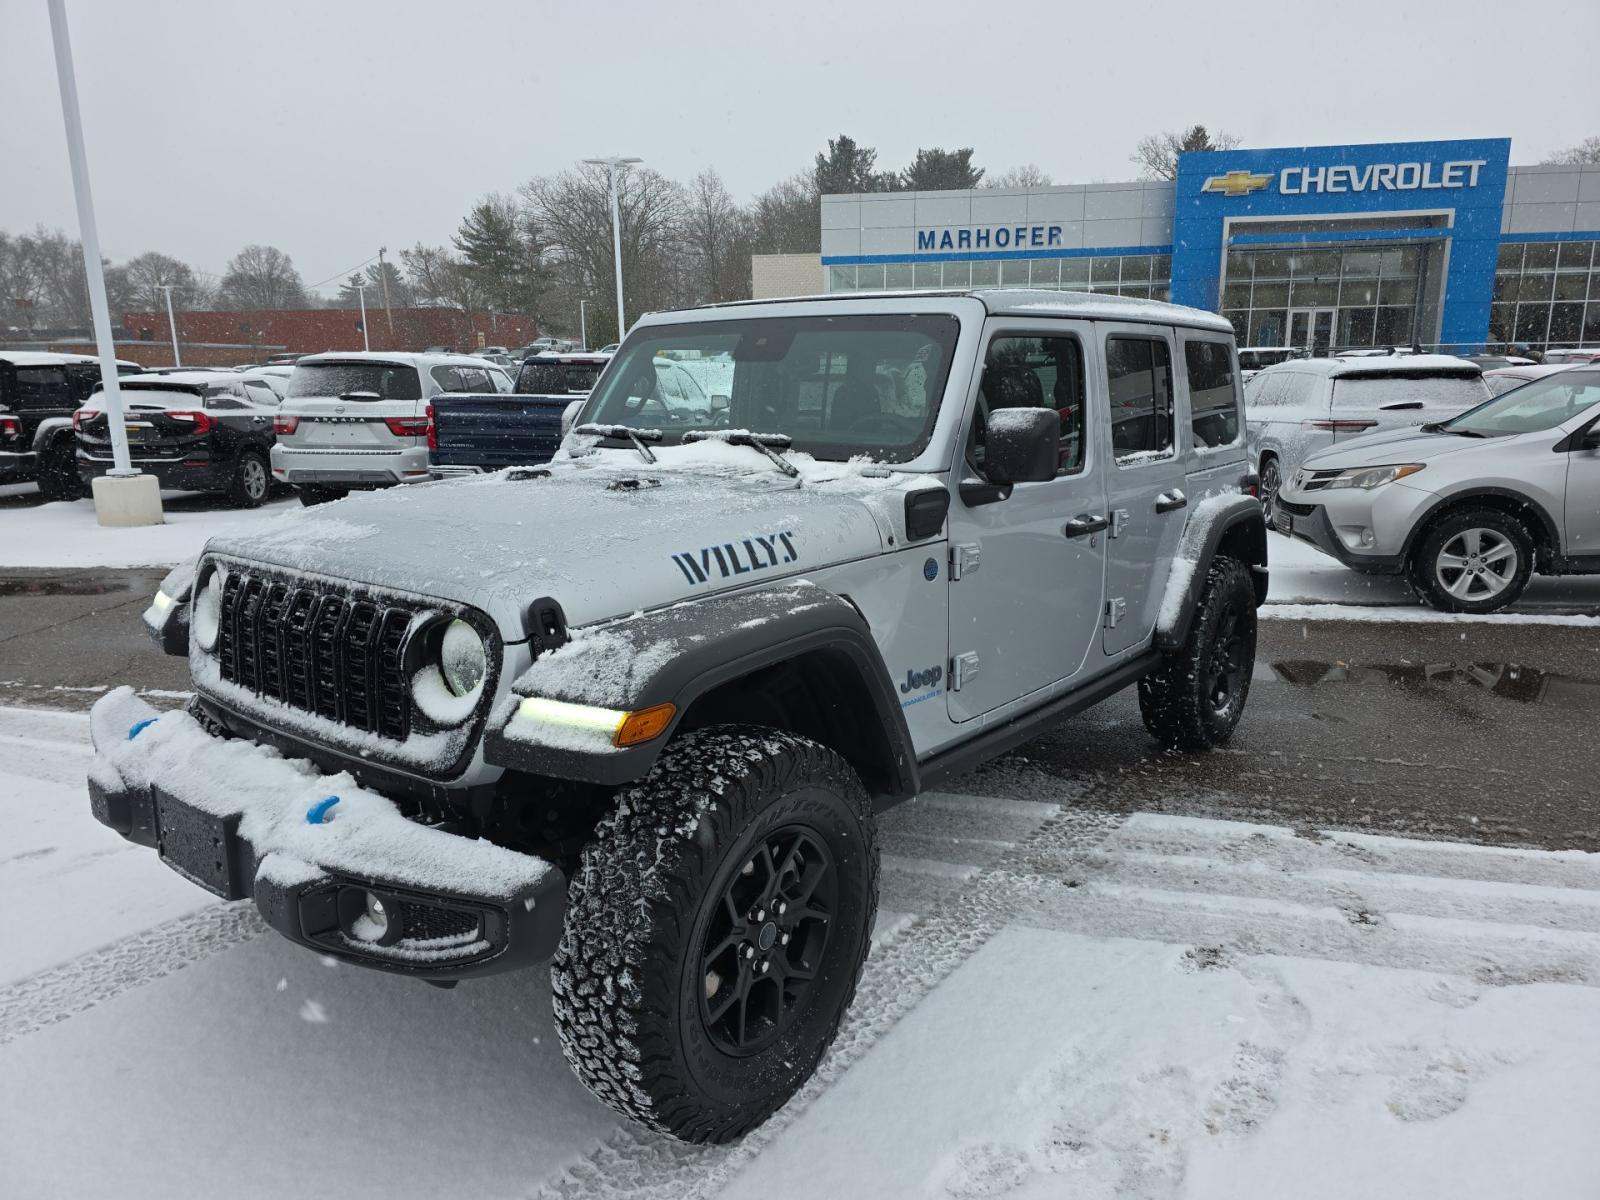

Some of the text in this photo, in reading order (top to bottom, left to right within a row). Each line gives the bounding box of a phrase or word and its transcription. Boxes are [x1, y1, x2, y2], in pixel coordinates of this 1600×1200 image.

[1279, 159, 1487, 195] CHEVROLET
[918, 226, 1062, 249] MARHOFER
[671, 530, 798, 585] WILLYS
[901, 665, 943, 694] Jeep
